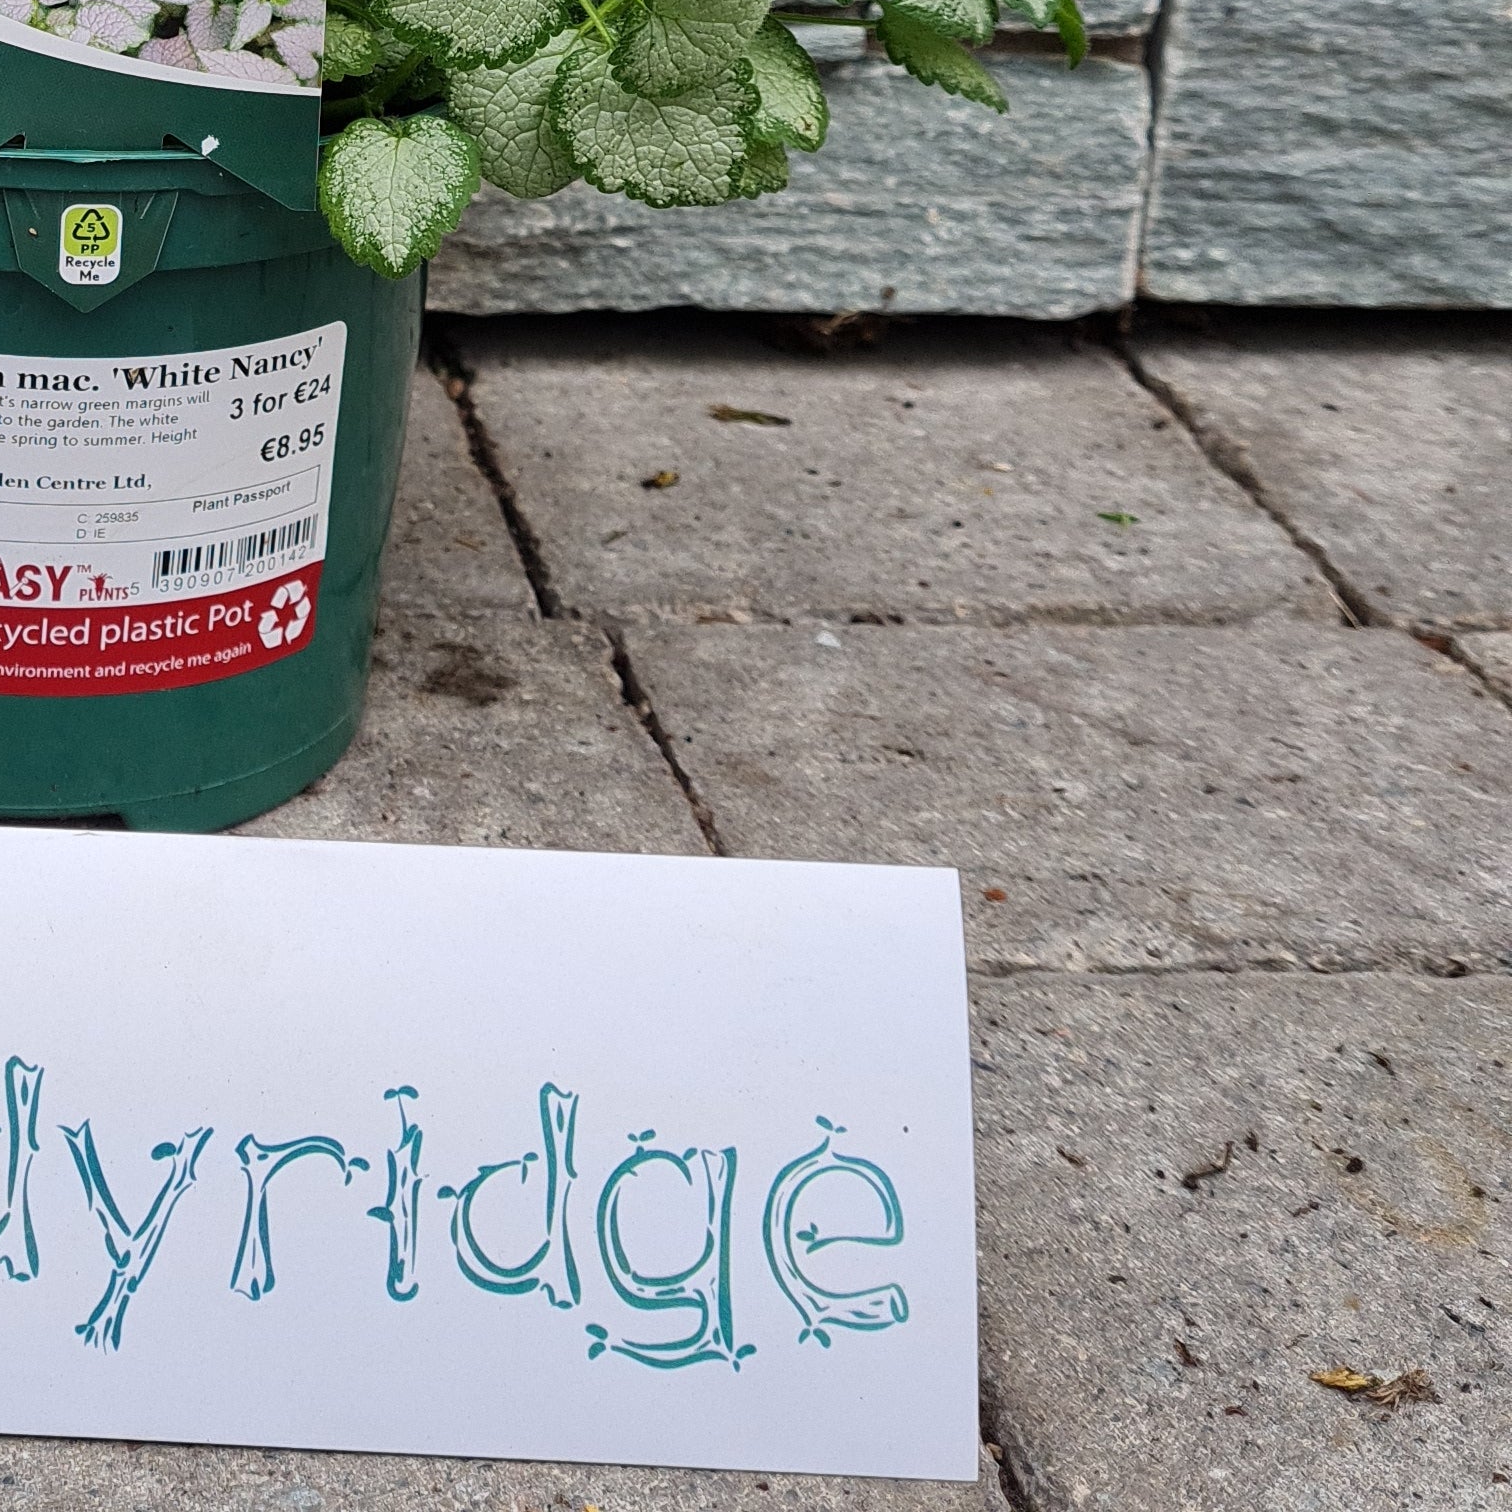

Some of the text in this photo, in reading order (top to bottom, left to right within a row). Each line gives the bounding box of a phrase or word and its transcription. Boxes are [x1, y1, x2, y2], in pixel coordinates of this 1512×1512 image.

[81, 244, 99, 254] PP
[66, 256, 115, 269] Recycle
[80, 270, 99, 281] Me
[16, 372, 99, 392] mac.
[21, 399, 73, 410] narrow
[78, 399, 120, 414] green
[126, 396, 182, 410] margins
[187, 391, 211, 404] will
[229, 374, 331, 420] 3 for €24
[18, 415, 42, 427] the
[47, 415, 103, 431] garden.
[110, 416, 134, 428] The
[140, 415, 178, 427] white
[11, 433, 58, 449] spring
[63, 433, 78, 447] to
[84, 436, 146, 447] summer.
[152, 428, 198, 445] Height
[261, 423, 325, 462] €8.95
[36, 474, 107, 491] Centre
[113, 474, 152, 490] Ltd,
[192, 481, 291, 513] Plant Passport
[96, 512, 139, 523] 259835
[94, 528, 105, 538] IE
[100, 611, 200, 651] plastic
[208, 600, 253, 632] Pot
[95, 659, 125, 677] and
[130, 654, 184, 675] recycle
[188, 653, 210, 667] me
[214, 641, 252, 663] again
